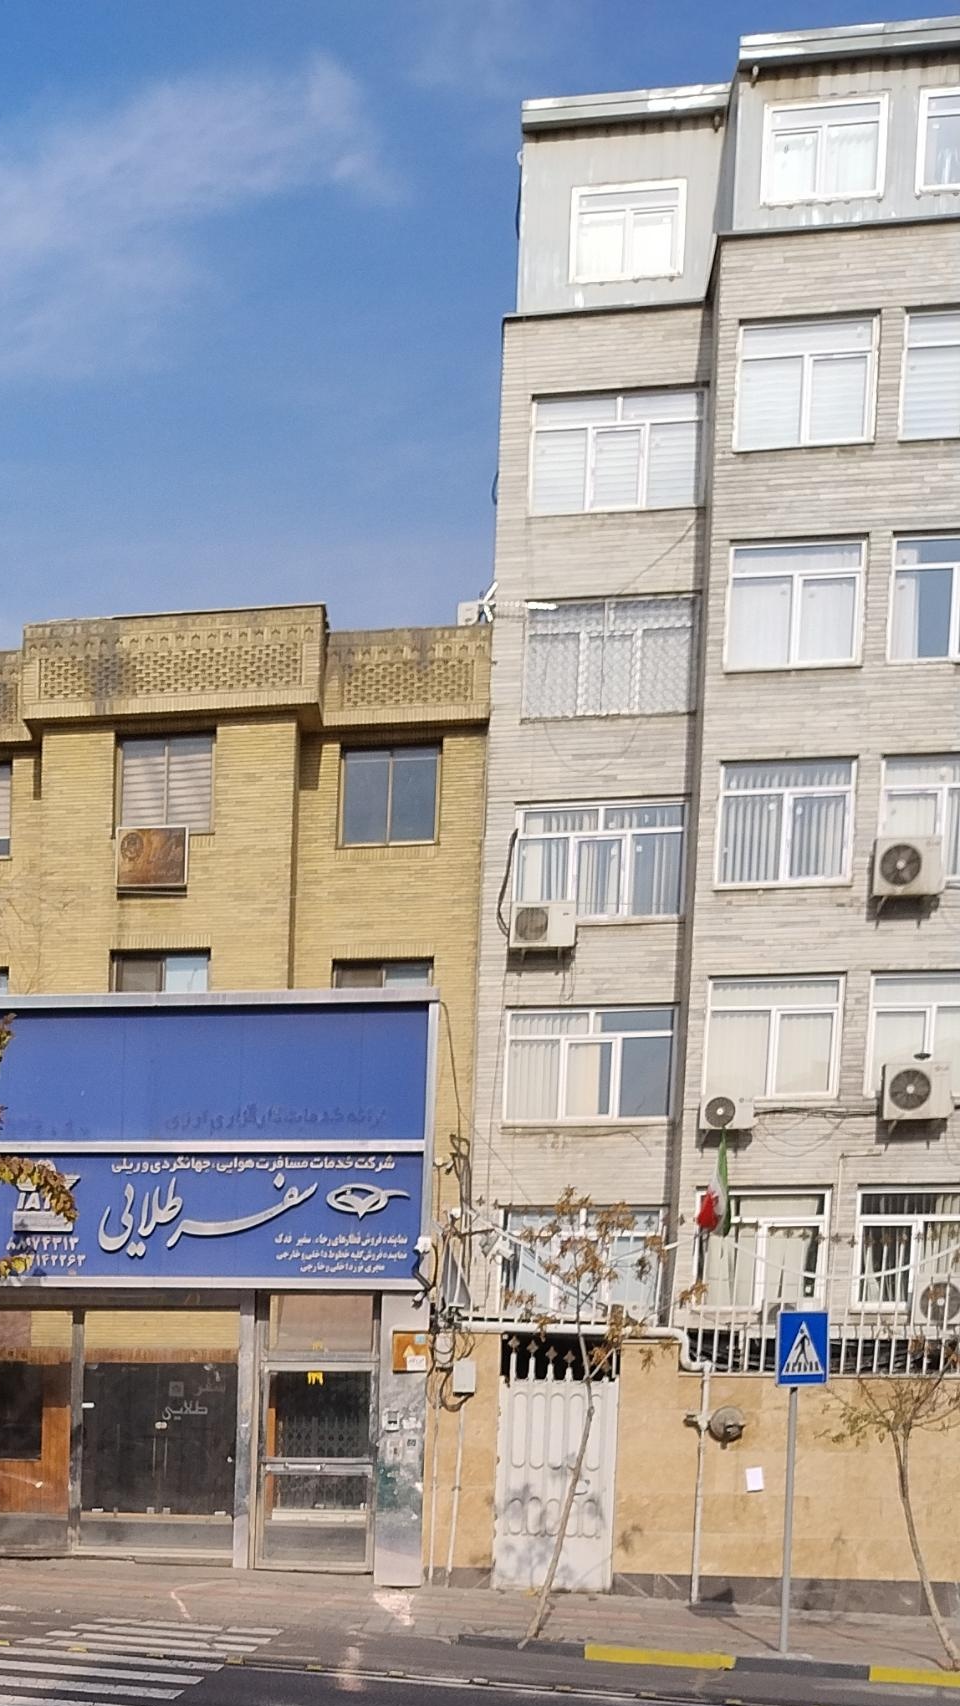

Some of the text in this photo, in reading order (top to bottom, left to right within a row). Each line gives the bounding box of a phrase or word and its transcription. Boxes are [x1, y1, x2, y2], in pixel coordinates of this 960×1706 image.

[111, 1158, 140, 1174] ریلی
[150, 1155, 211, 1173] جهانگردی
[255, 1155, 309, 1172] مسافرت
[310, 1156, 353, 1170] خدمات
[354, 1155, 395, 1173] شرکت
[98, 1173, 318, 1257] سفر طلایی
[362, 1233, 382, 1246] فروش
[363, 1249, 382, 1260] فروش
[162, 1400, 208, 1420] طلایی
